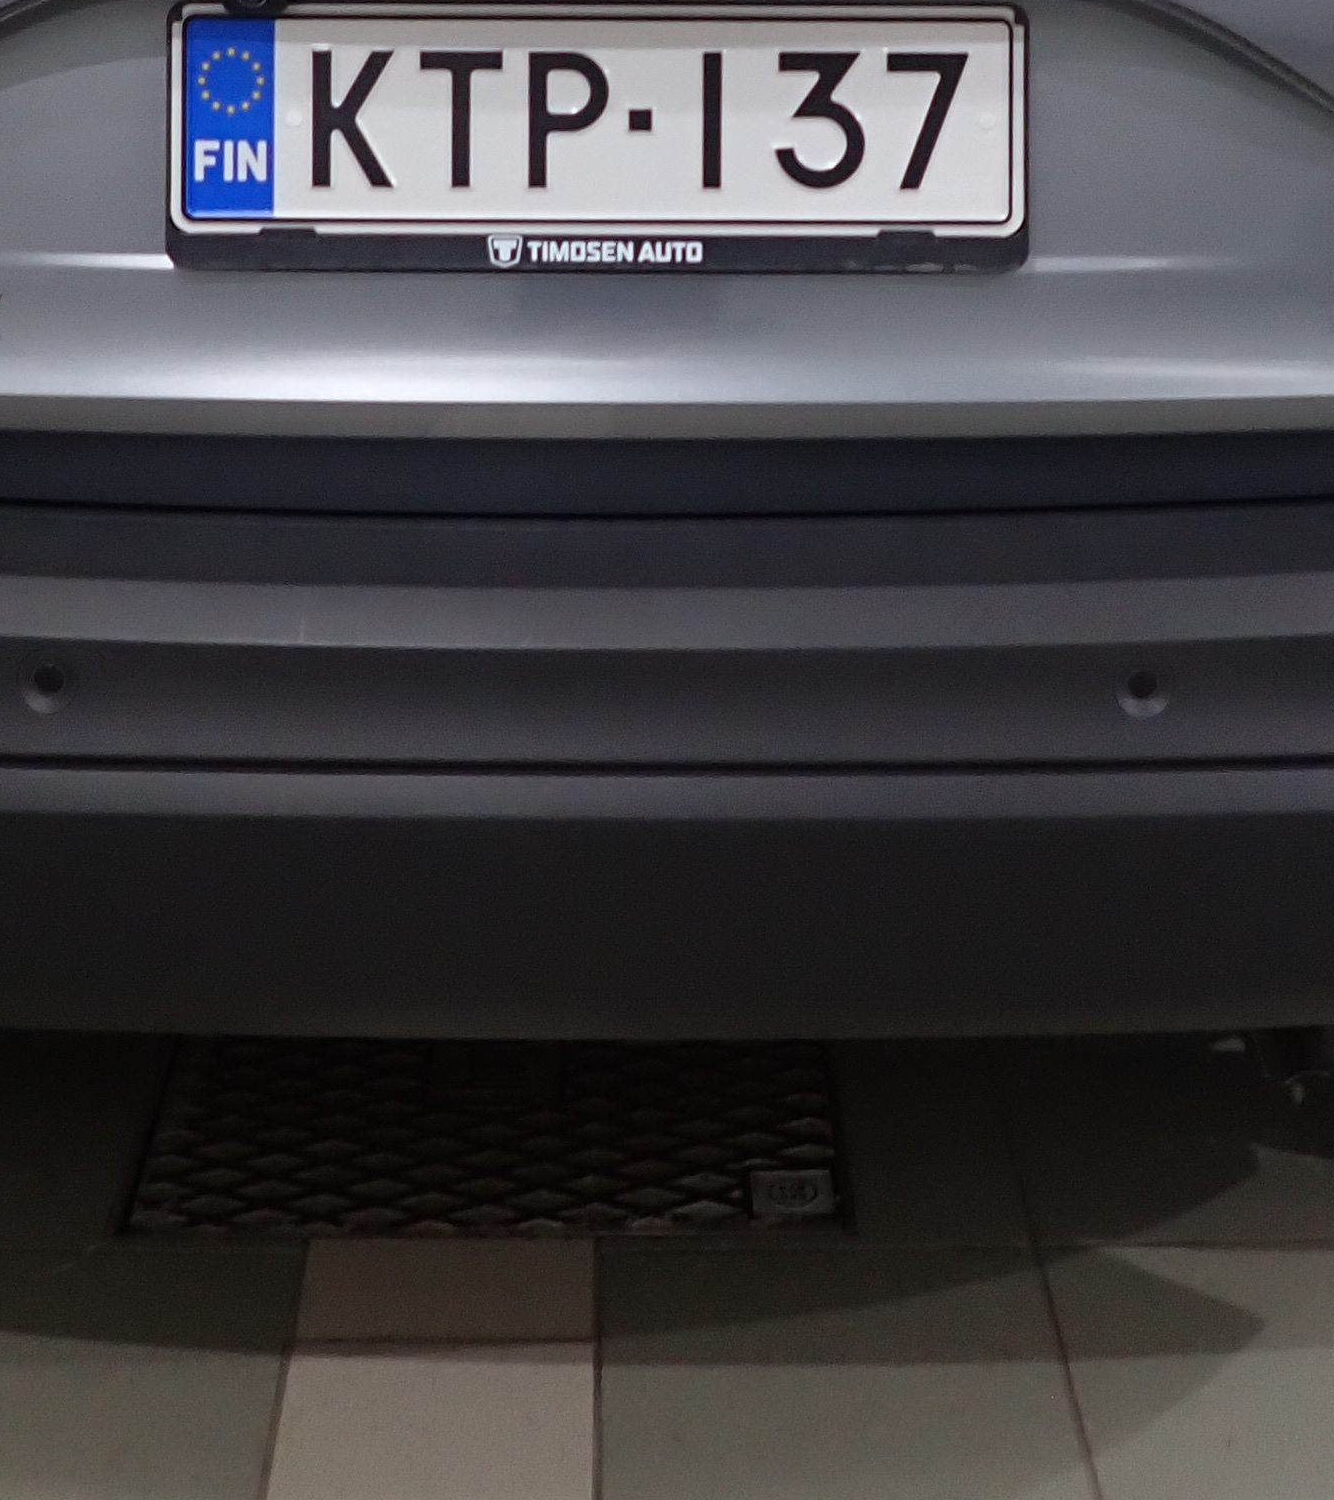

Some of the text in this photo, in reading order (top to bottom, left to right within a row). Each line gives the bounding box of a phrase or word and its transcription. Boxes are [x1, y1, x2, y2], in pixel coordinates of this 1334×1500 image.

[310, 49, 970, 190] KTP-137
[193, 140, 267, 182] FIN
[527, 240, 634, 263] TIMOSEN
[637, 240, 703, 263] AUTO
